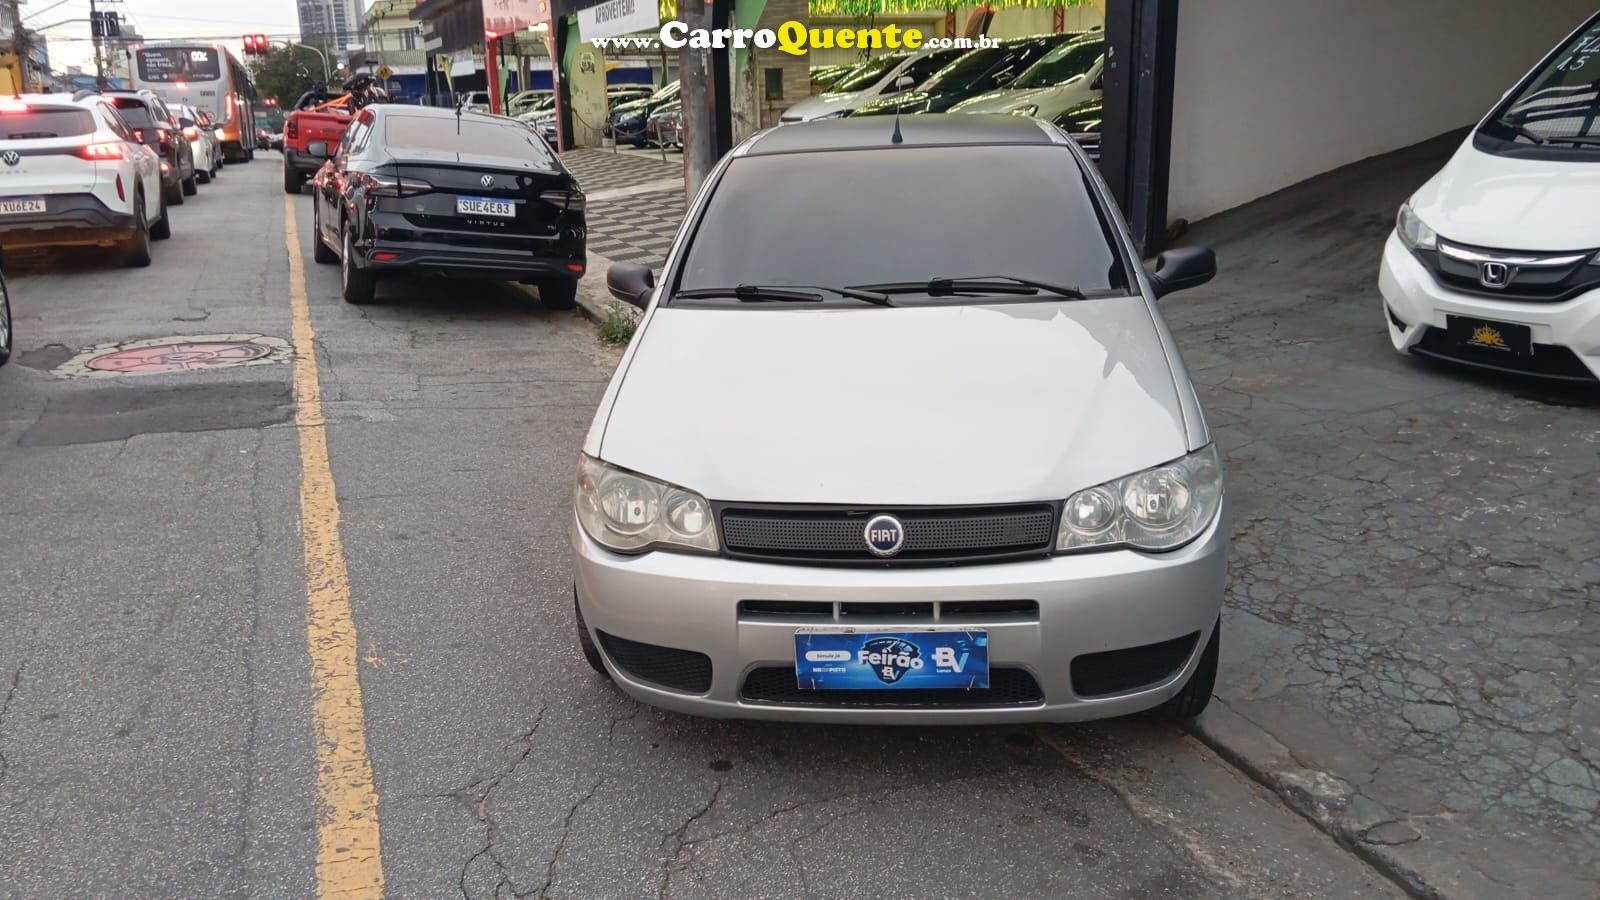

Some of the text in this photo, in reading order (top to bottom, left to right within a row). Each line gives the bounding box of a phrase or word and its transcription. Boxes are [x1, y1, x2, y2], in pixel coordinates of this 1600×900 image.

[0, 200, 41, 212] XU6E24
[462, 201, 510, 214] SUE4E83
[871, 529, 896, 542] FIAT
[858, 649, 924, 669] Feirão
